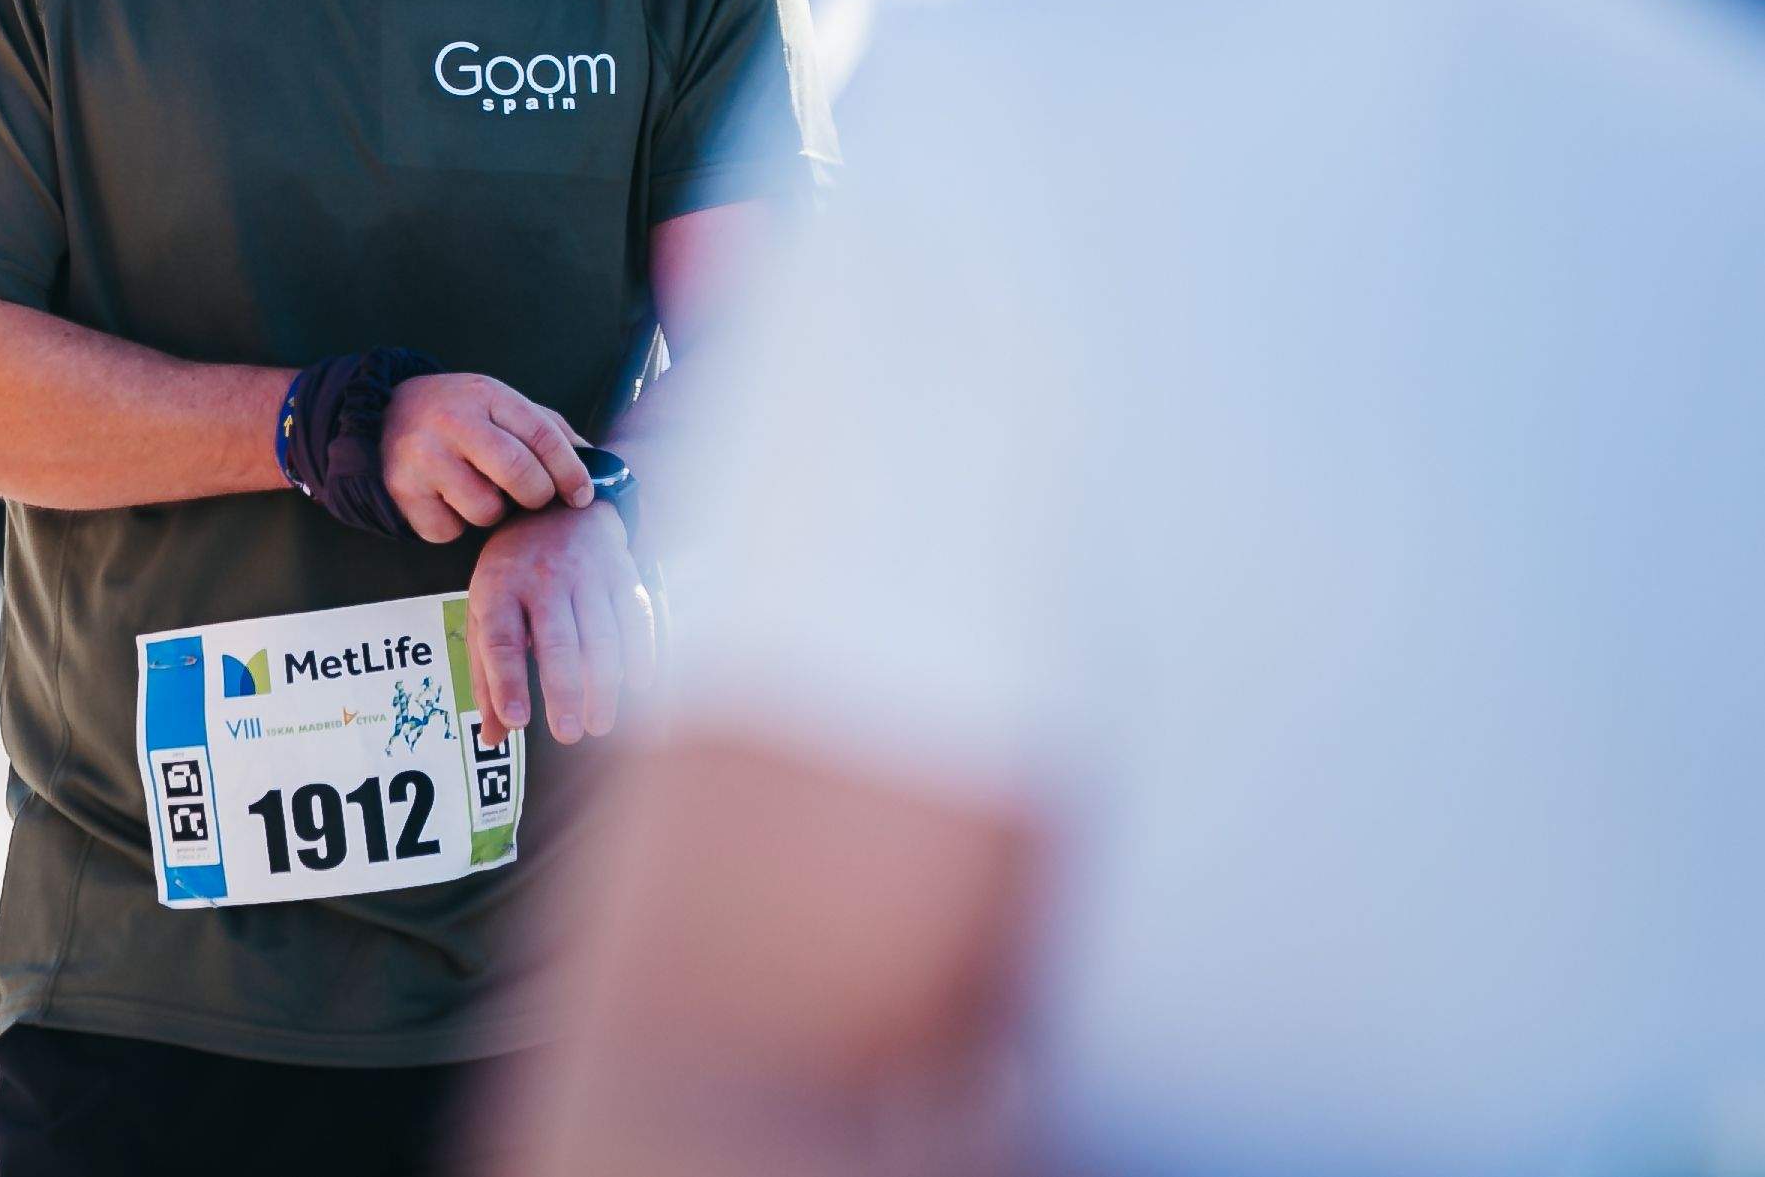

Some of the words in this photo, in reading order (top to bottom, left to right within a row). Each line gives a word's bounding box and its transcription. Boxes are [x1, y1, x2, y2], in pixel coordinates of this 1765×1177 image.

[435, 40, 617, 96] Goom
[482, 94, 577, 115] spain
[284, 636, 433, 684] MetLife
[225, 717, 262, 740] VIII
[299, 720, 342, 733] MADRID
[248, 770, 442, 874] 1912
